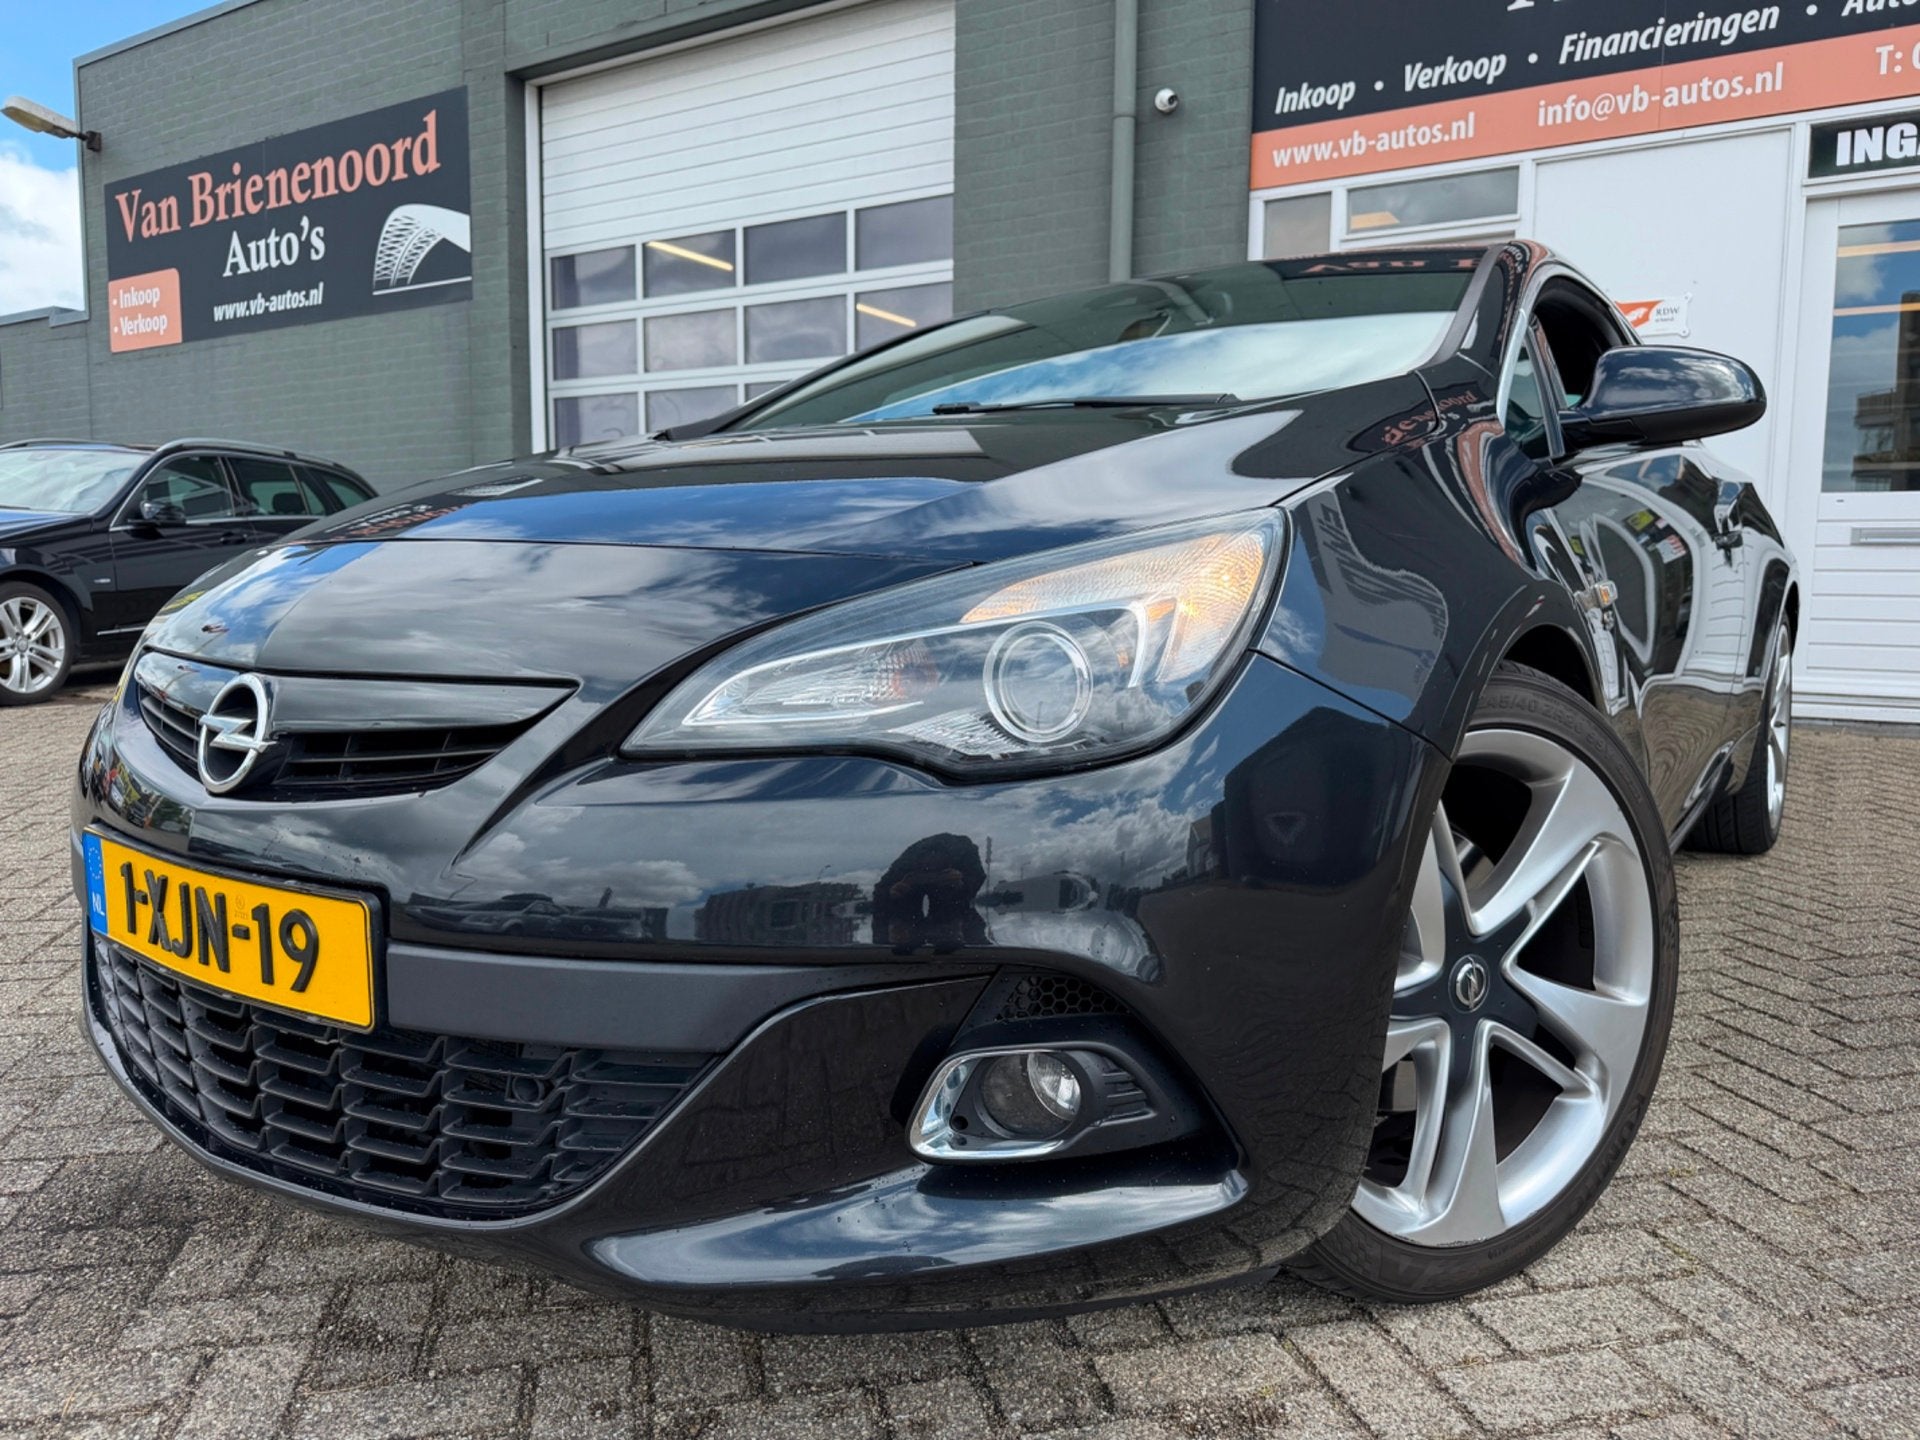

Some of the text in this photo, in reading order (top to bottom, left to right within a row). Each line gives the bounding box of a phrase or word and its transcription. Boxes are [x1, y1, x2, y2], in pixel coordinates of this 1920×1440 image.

[1841, 0, 1919, 16] Au
[1275, 5, 1780, 115] Inkoop Verkoop Financieringen
[1272, 111, 1476, 168] www.vb-autos.nl
[1537, 61, 1784, 127] info@vb-autos.nl
[1875, 44, 1903, 76] T:
[1835, 121, 1920, 167] ING
[115, 109, 441, 243] Van Brienenoord
[222, 215, 326, 277] Auto's
[119, 283, 161, 309] Inkoop
[213, 282, 324, 322] www.vb-autos.nl
[1656, 306, 1680, 317] RDW
[120, 312, 168, 336] Verkoop
[92, 891, 106, 917] NL
[120, 861, 319, 992] 1-XJN-19
